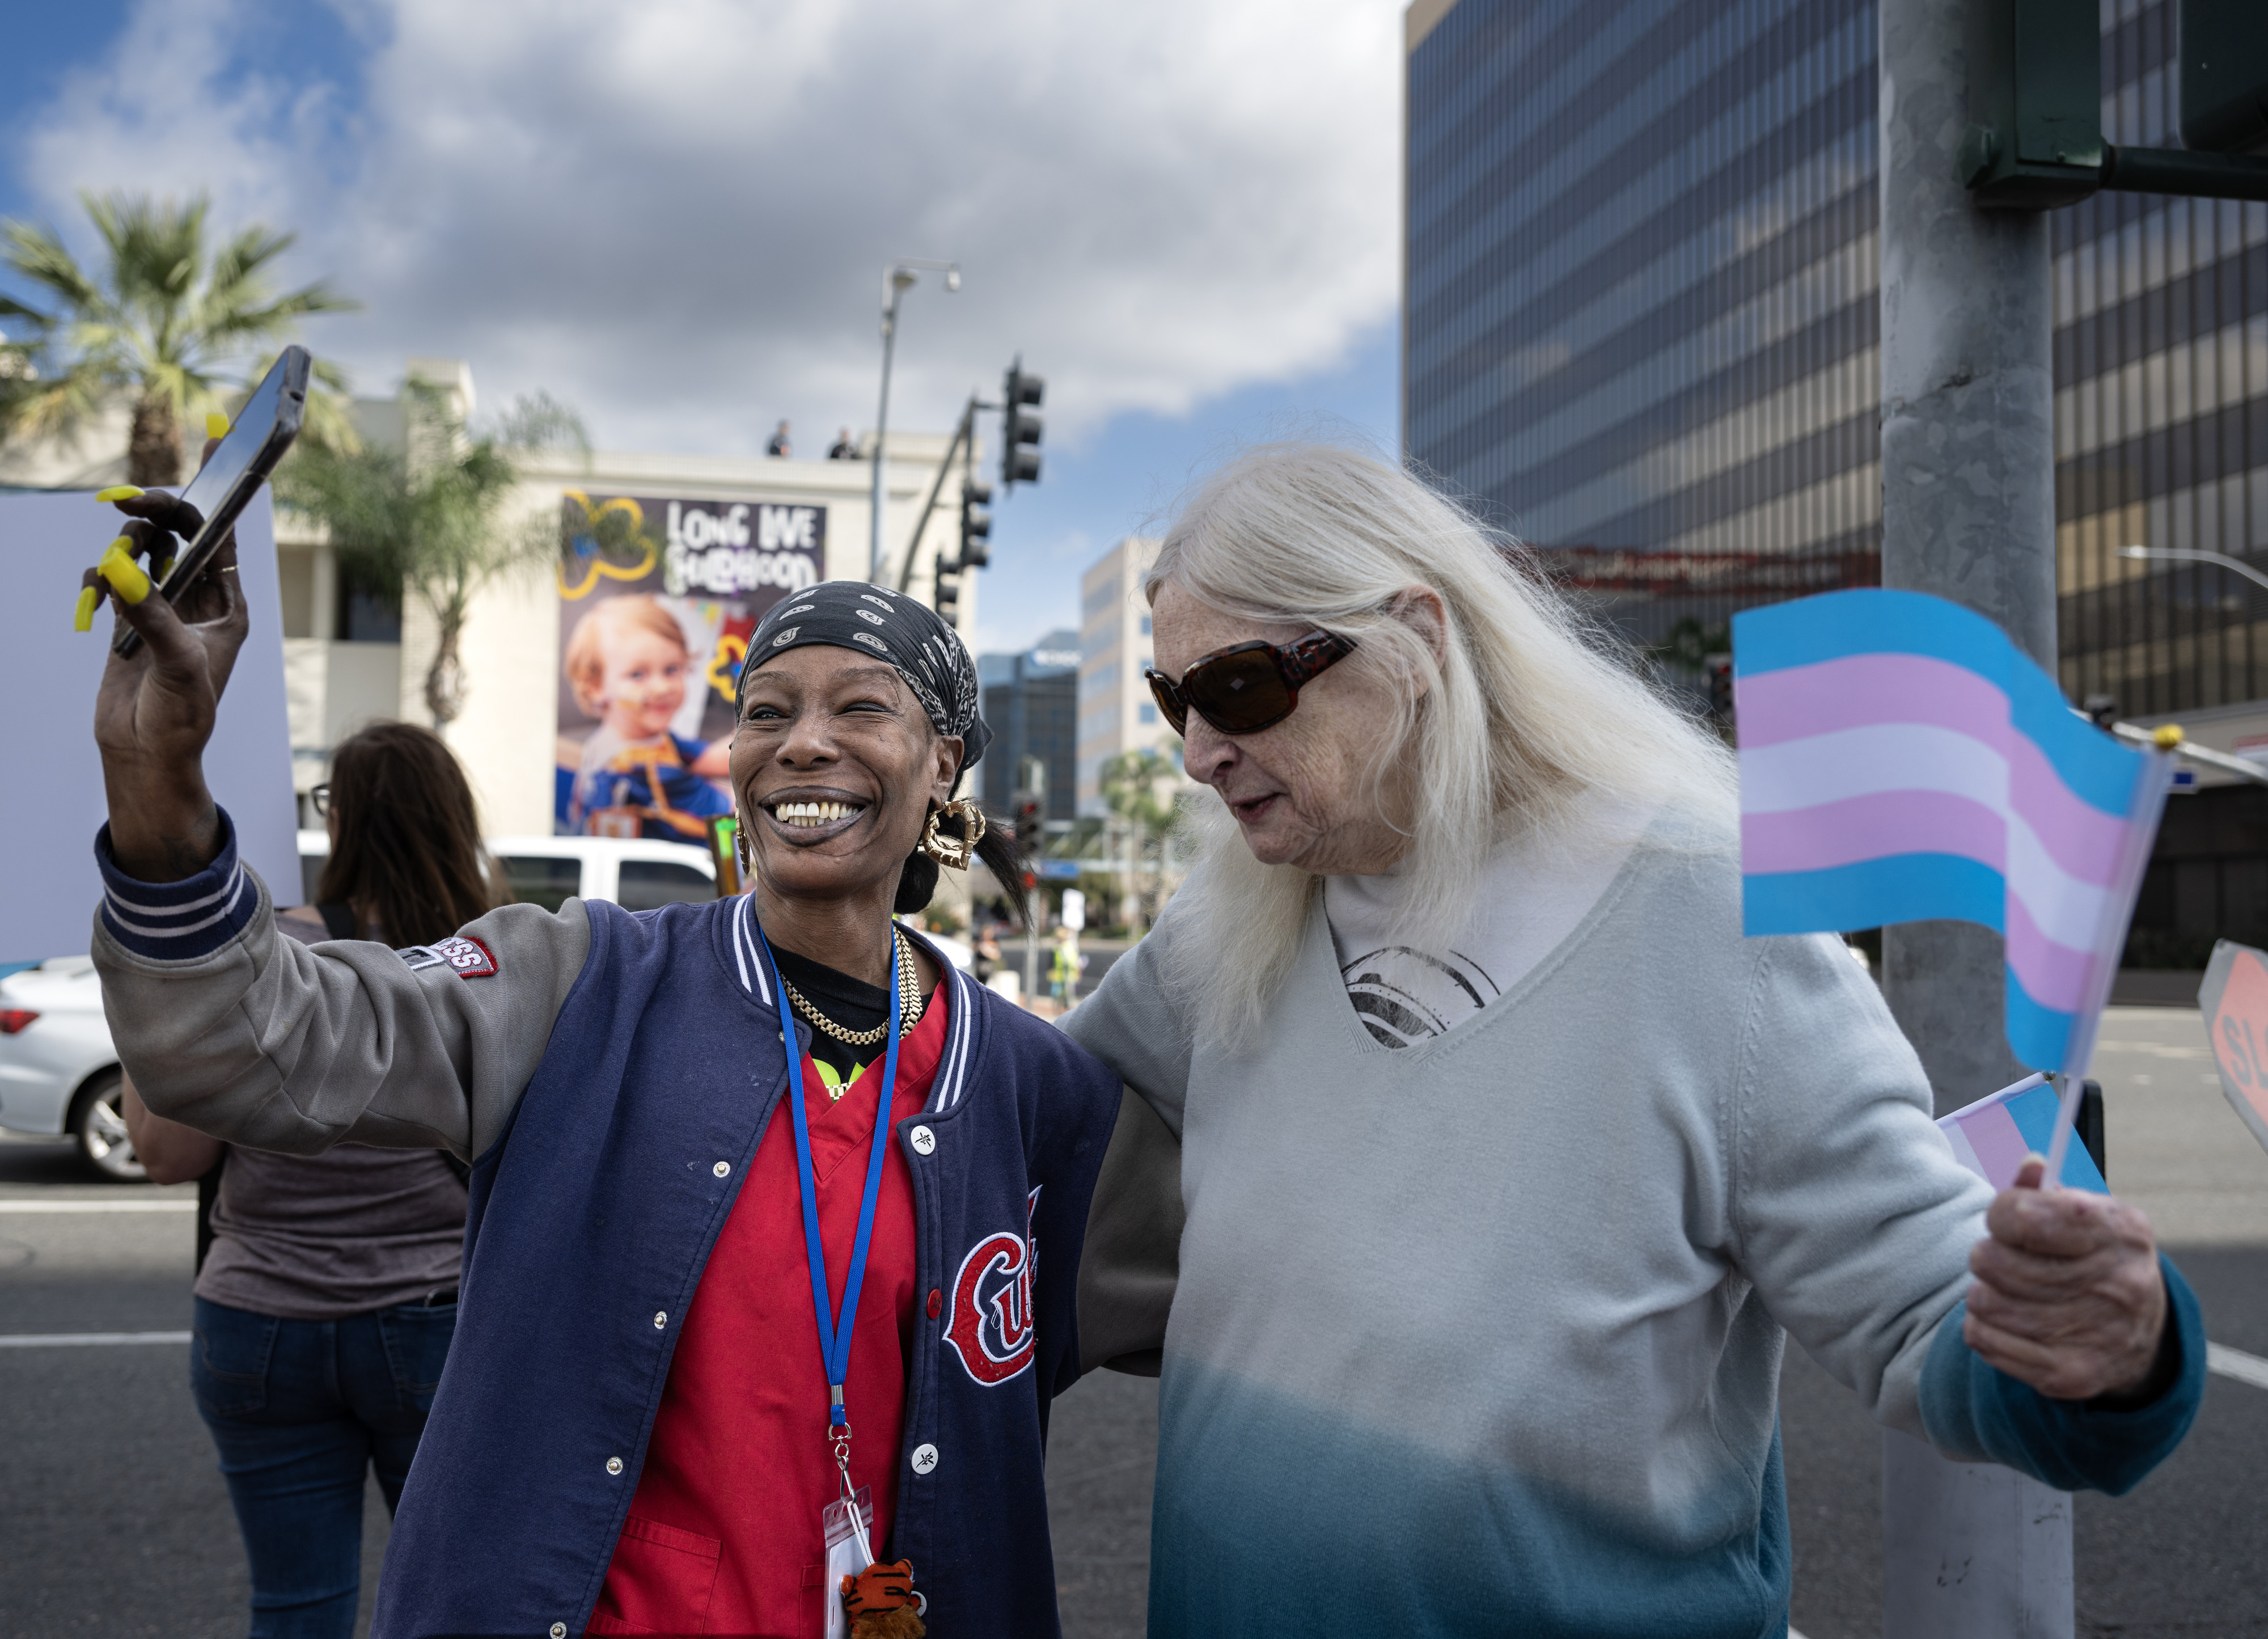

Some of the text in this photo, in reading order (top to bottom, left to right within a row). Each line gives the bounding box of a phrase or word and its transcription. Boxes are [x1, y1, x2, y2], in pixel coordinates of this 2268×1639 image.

[667, 501, 817, 551] LONG LIVE
[428, 936, 483, 968] ESS
[2222, 1015, 2268, 1089] SL
